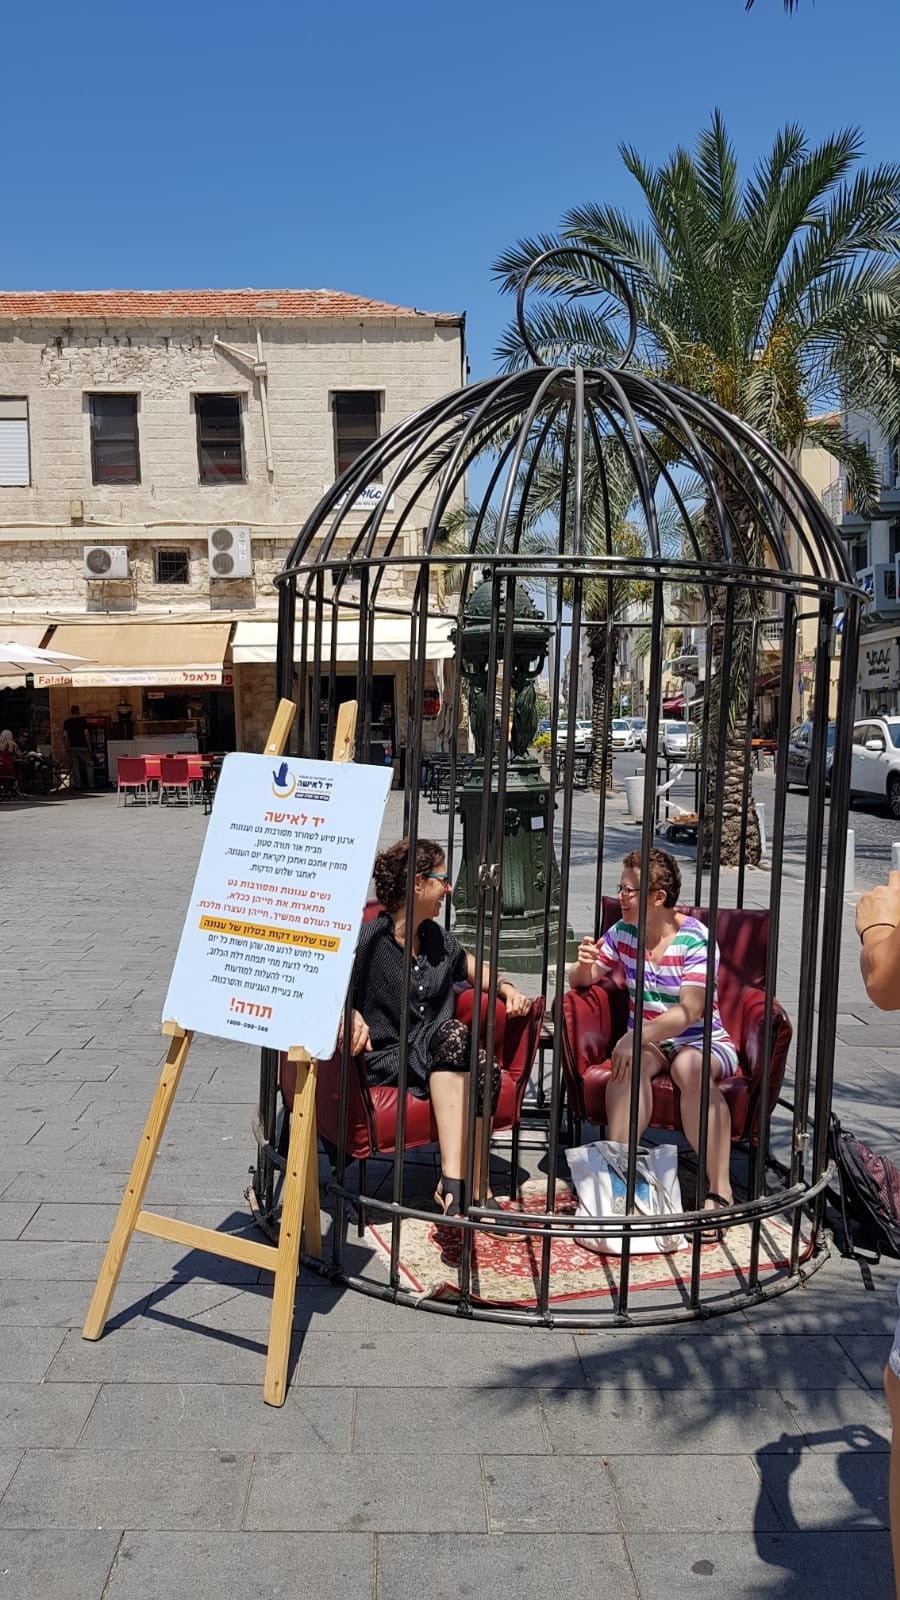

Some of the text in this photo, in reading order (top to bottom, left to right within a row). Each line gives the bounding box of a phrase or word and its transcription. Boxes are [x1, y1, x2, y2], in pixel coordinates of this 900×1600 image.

[182, 672, 217, 681] פלאפל
[297, 780, 333, 790] יד לאישה
[264, 811, 325, 827] יד לאישה
[230, 822, 253, 832] ועגונות
[264, 827, 292, 837] מסורבות
[294, 831, 319, 840] לשחרור
[336, 836, 355, 845] ארגון
[273, 841, 290, 850] תורה
[292, 843, 303, 851] אור
[304, 845, 322, 854] מבית
[262, 852, 286, 863] לקראת
[286, 855, 307, 865] ואתכן
[307, 858, 327, 868] אתכם
[328, 861, 348, 871] מזמין
[274, 867, 294, 876] שלוש
[295, 870, 317, 879] לאתגר
[240, 880, 278, 892] ומסורבות
[280, 887, 307, 897] עגונות
[310, 891, 331, 901] נשים
[252, 895, 273, 905] חייהן
[275, 899, 288, 907] את
[223, 904, 246, 914] נעצרו
[290, 901, 325, 913] מתארות
[248, 908, 269, 917] חייהן
[303, 917, 330, 927] העולם
[332, 921, 352, 931] בעוד
[204, 919, 336, 947] שבו שלוש דקות בסלון של עגונה
[208, 934, 325, 961] כדי לחוש לרגע מה שהן חשות כל יום
[229, 951, 244, 960] דלת
[267, 958, 281, 967] מתי
[281, 960, 301, 970] לדעת
[224, 963, 295, 983] וכדי להעלות למודעות
[302, 963, 319, 974] מבלי
[271, 986, 291, 997] בעיית
[292, 990, 304, 999] את
[229, 997, 272, 1019] תודה!
